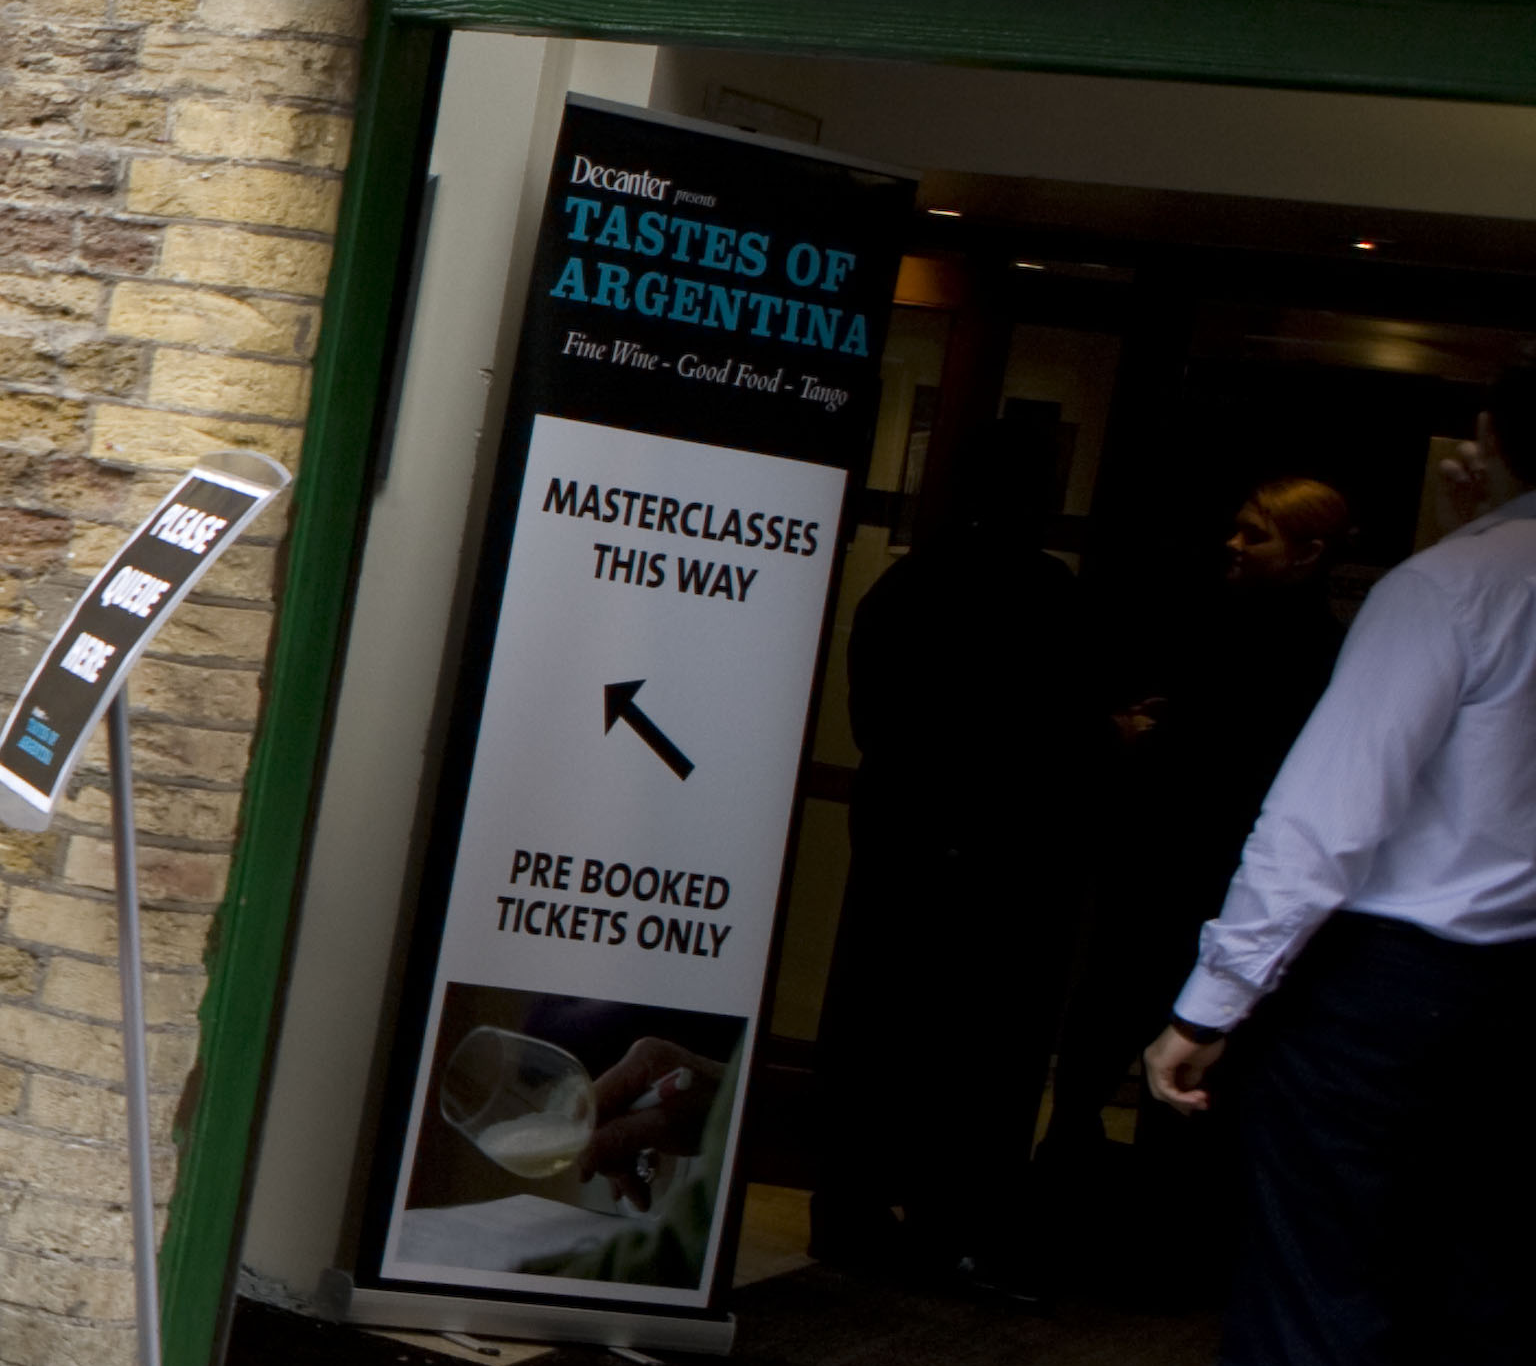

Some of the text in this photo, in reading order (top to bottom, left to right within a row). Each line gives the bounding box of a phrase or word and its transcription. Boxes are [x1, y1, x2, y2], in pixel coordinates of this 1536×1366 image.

[570, 154, 717, 208] Decanter presents
[564, 195, 856, 293] TASTES OF
[549, 257, 869, 358] ARGENTINA
[562, 330, 606, 363] Fine
[611, 340, 657, 371] Wine
[678, 353, 729, 385] Good
[734, 362, 781, 393] Food
[800, 375, 849, 413] Tango
[149, 502, 230, 555] PLEASE
[542, 477, 819, 557] MASTERCLASSES
[100, 564, 171, 618] QUEUE
[593, 542, 758, 603] THIS WAY
[60, 631, 116, 684] HERE
[509, 849, 731, 911] PRE BOOKED
[496, 896, 732, 959] TICKETS ONLY
